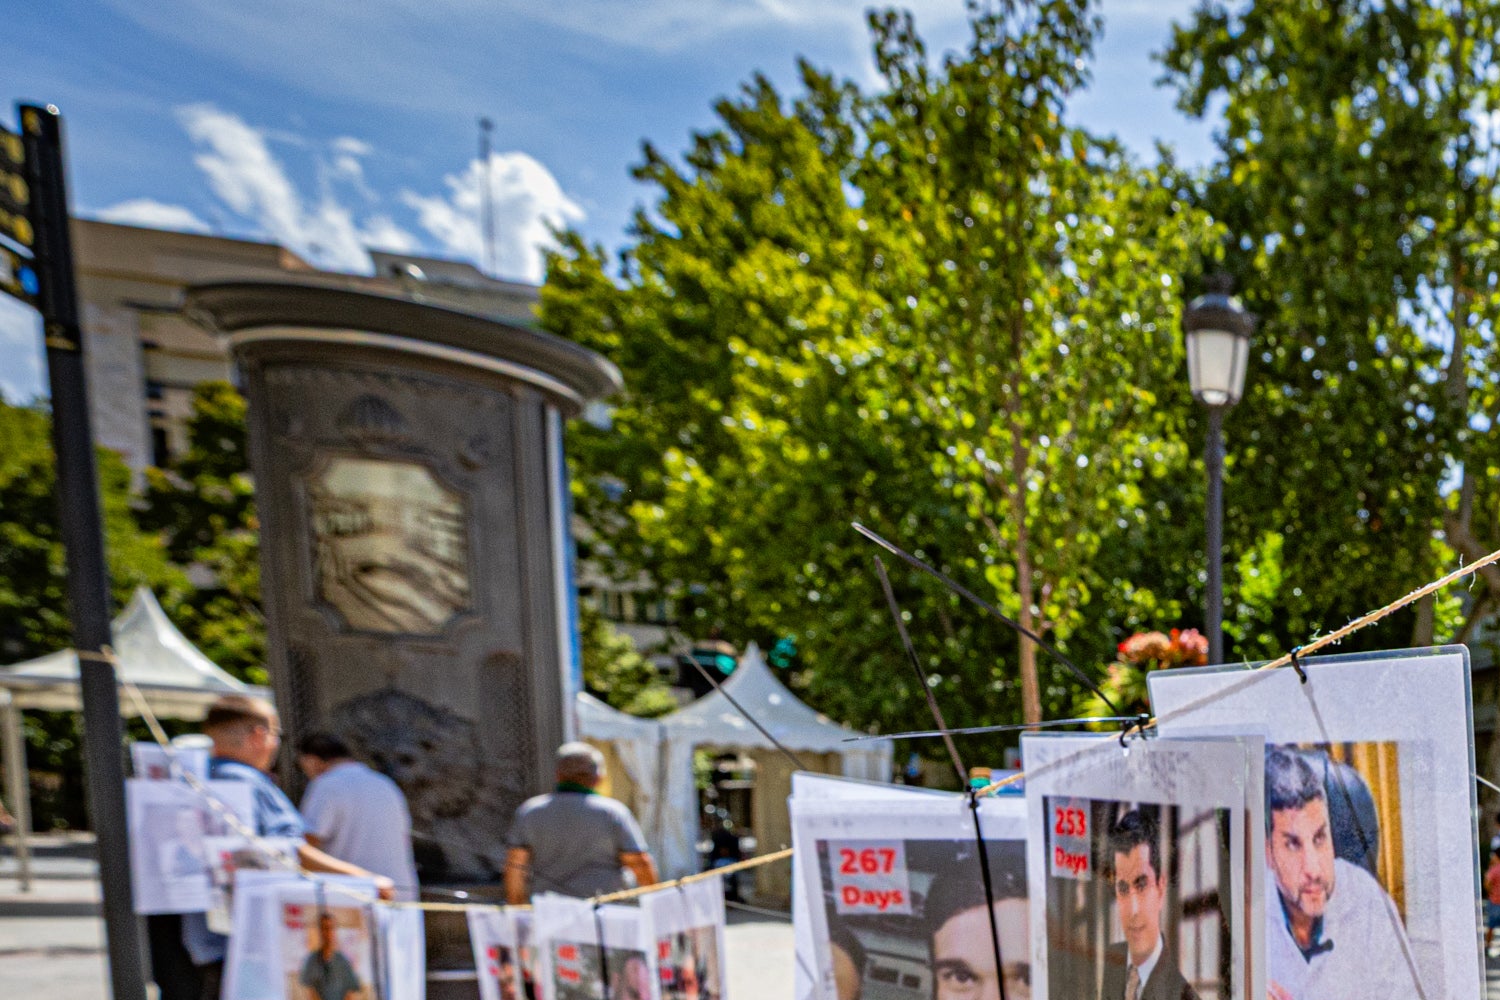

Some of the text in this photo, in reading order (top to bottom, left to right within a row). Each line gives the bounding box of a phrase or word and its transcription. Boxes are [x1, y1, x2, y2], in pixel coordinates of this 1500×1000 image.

[1055, 808, 1085, 836] 253
[840, 848, 895, 874] 267
[1055, 847, 1087, 874] Days
[842, 885, 902, 910] Days
